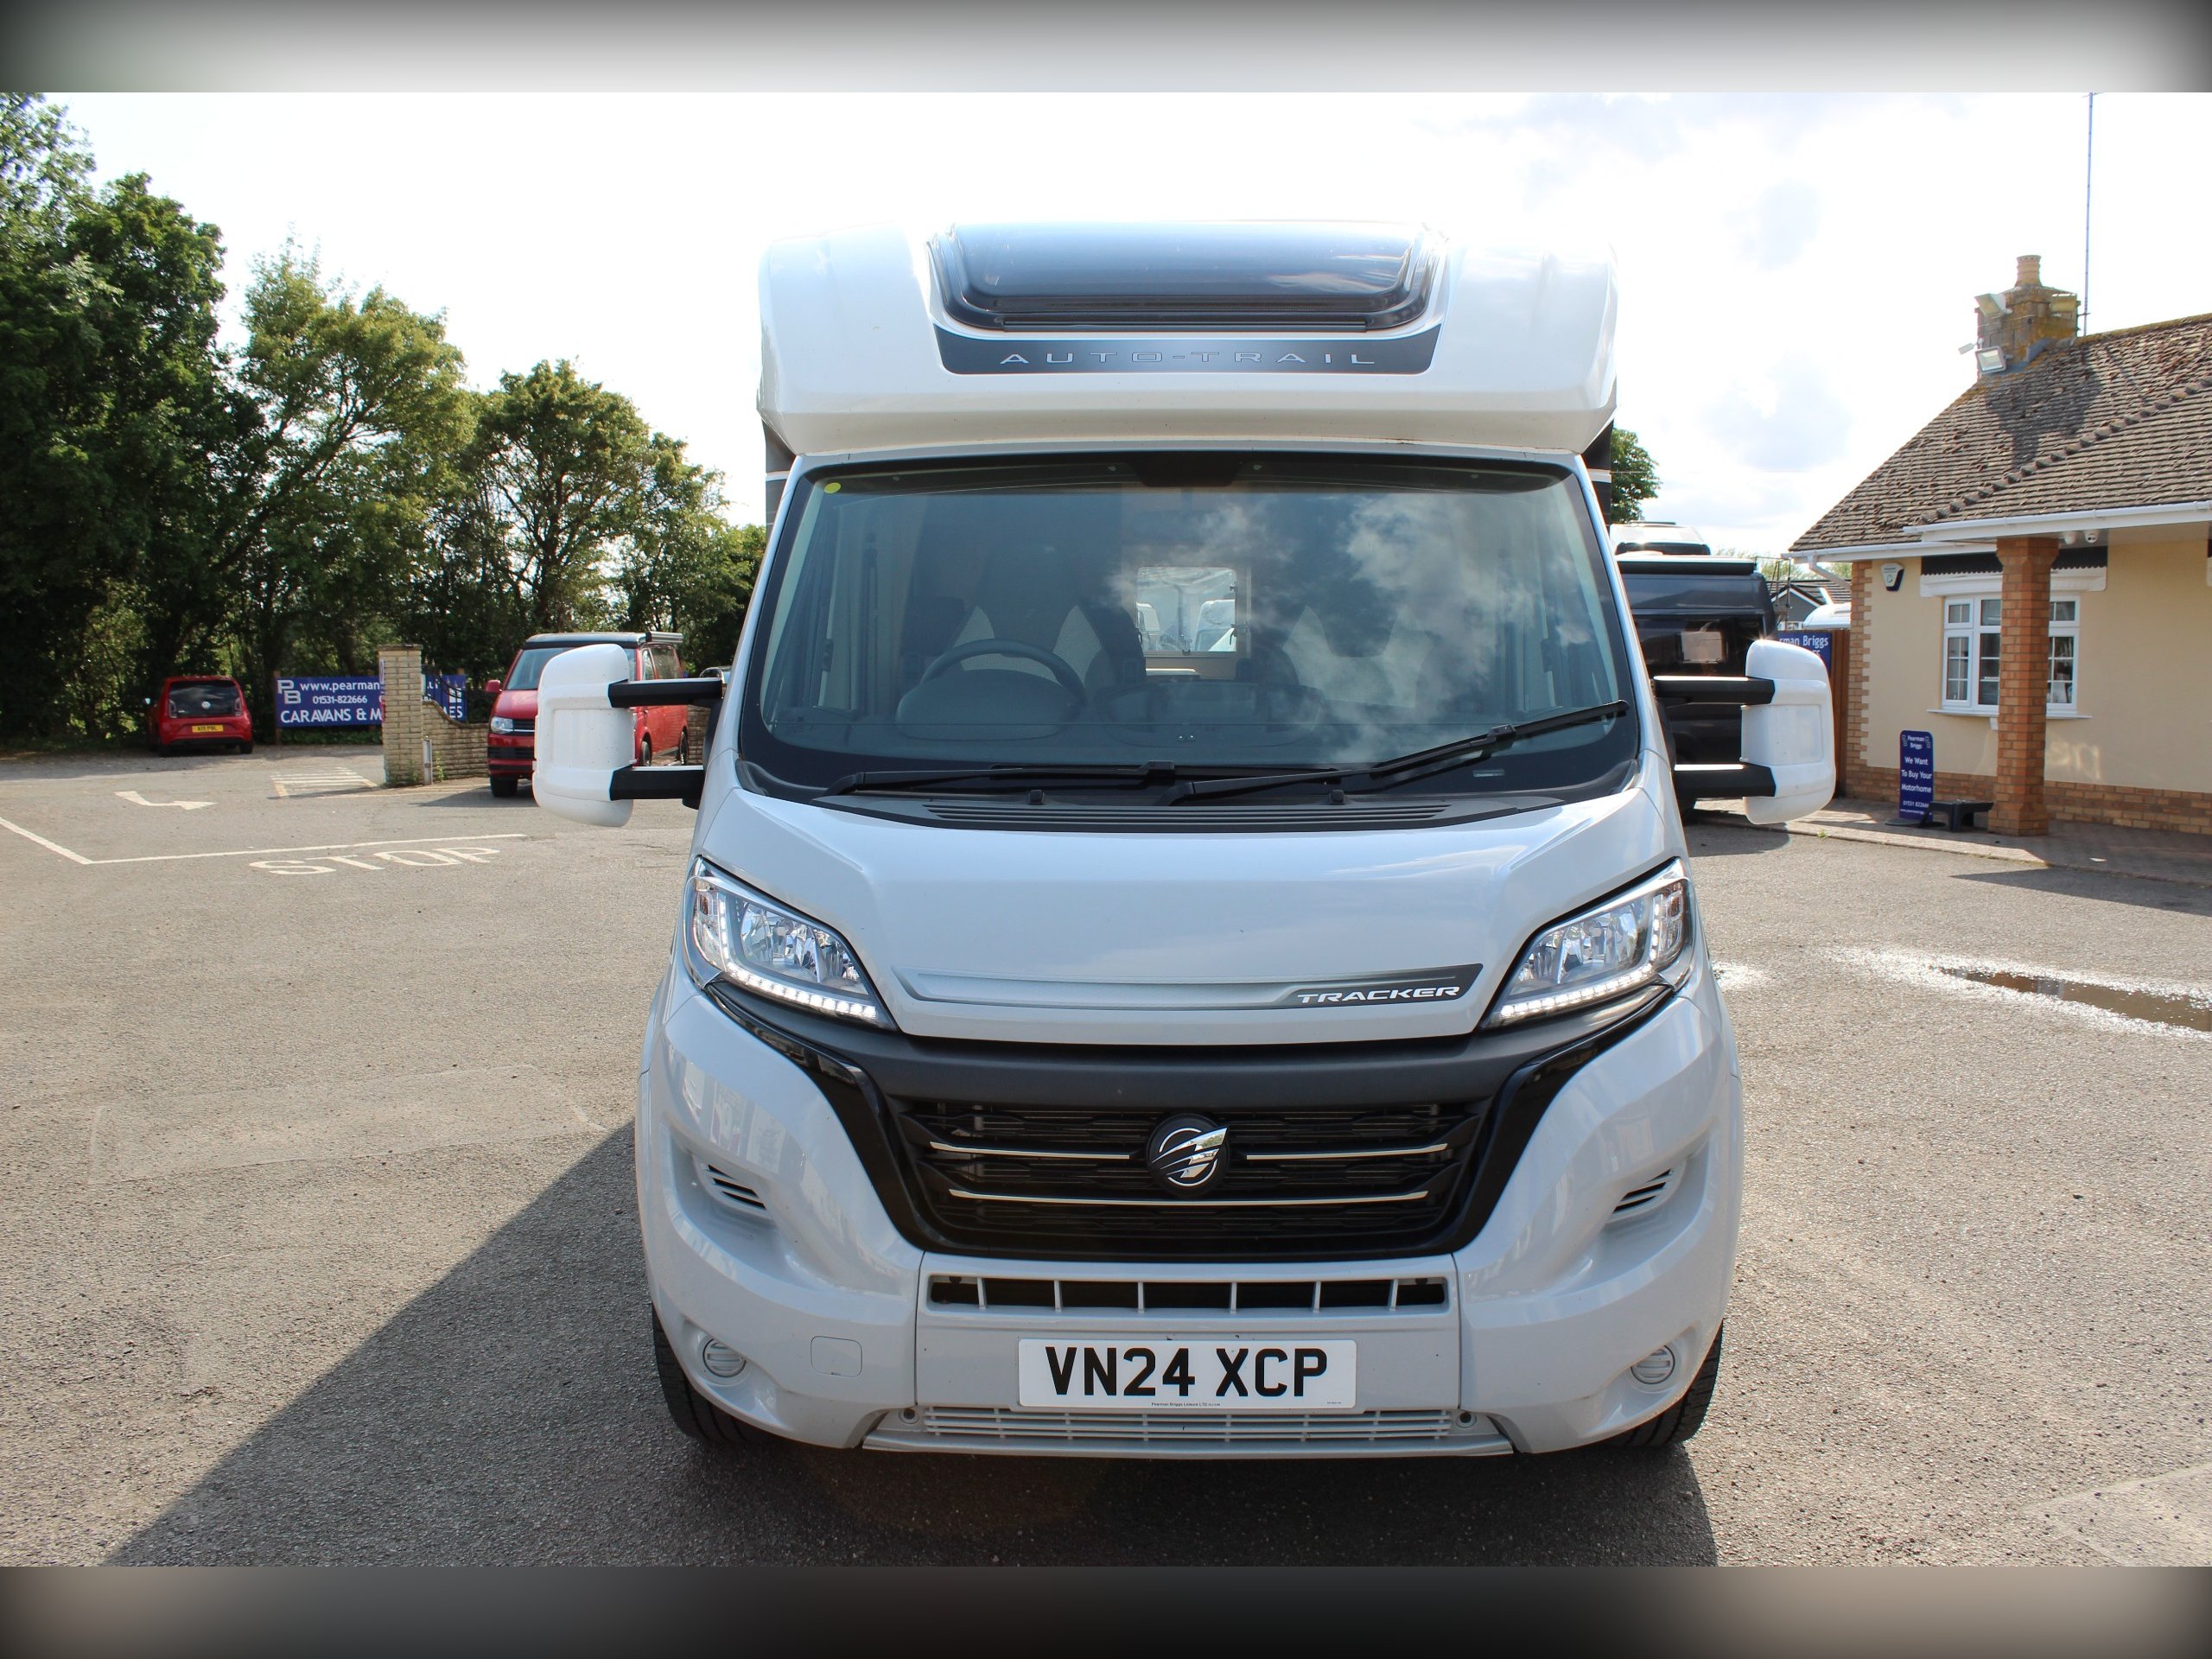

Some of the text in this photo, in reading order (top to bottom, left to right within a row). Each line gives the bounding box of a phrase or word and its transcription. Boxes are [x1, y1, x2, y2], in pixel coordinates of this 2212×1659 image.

[1000, 353, 1376, 365] AUTO-TRAIL
[1802, 634, 1829, 649] Briggs
[312, 695, 368, 704] 01531-822666
[280, 709, 352, 723] CARAVANS
[1904, 756, 1929, 766] We Want
[1901, 769, 1932, 780] To Buy Your
[1901, 784, 1932, 793] Motorhome
[249, 847, 501, 875] STOP
[1298, 986, 1460, 1004] TRACKER
[1045, 1346, 1328, 1397] VN24 XCP
